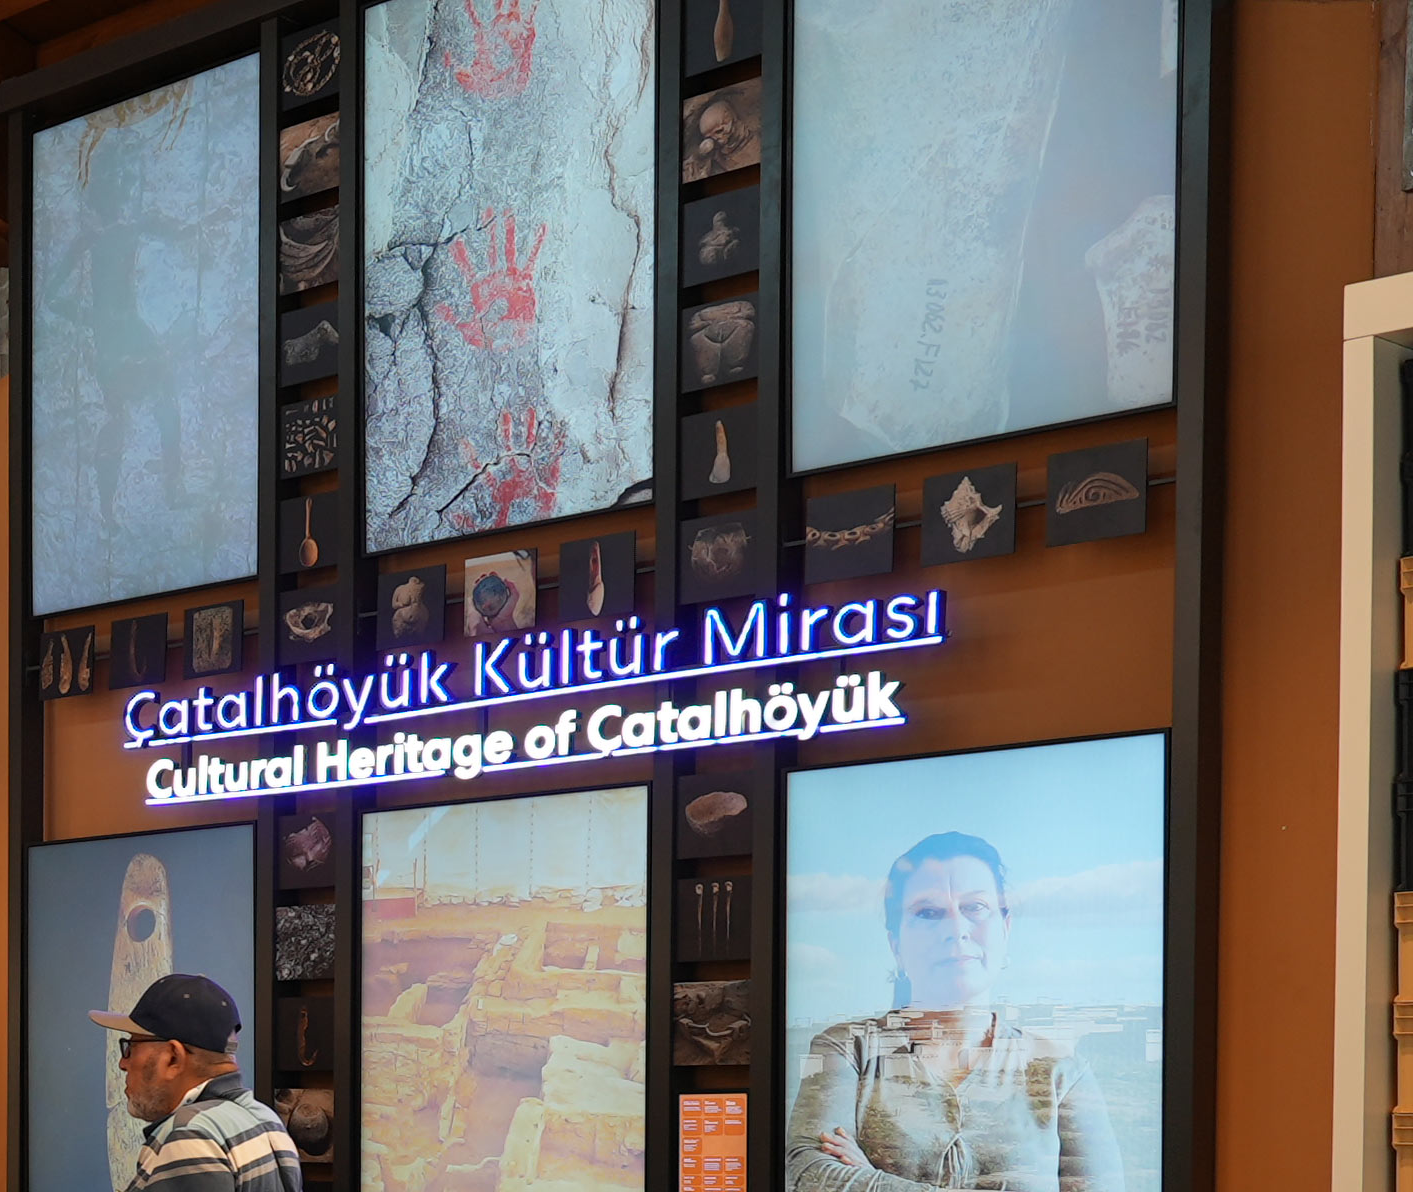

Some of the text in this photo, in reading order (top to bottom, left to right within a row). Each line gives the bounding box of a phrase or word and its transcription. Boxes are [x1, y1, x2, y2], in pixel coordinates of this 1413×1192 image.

[124, 590, 941, 748] Çatalhöyük Kültür Mirası
[146, 671, 900, 799] Cultural Heritage of Çatalhöyük
